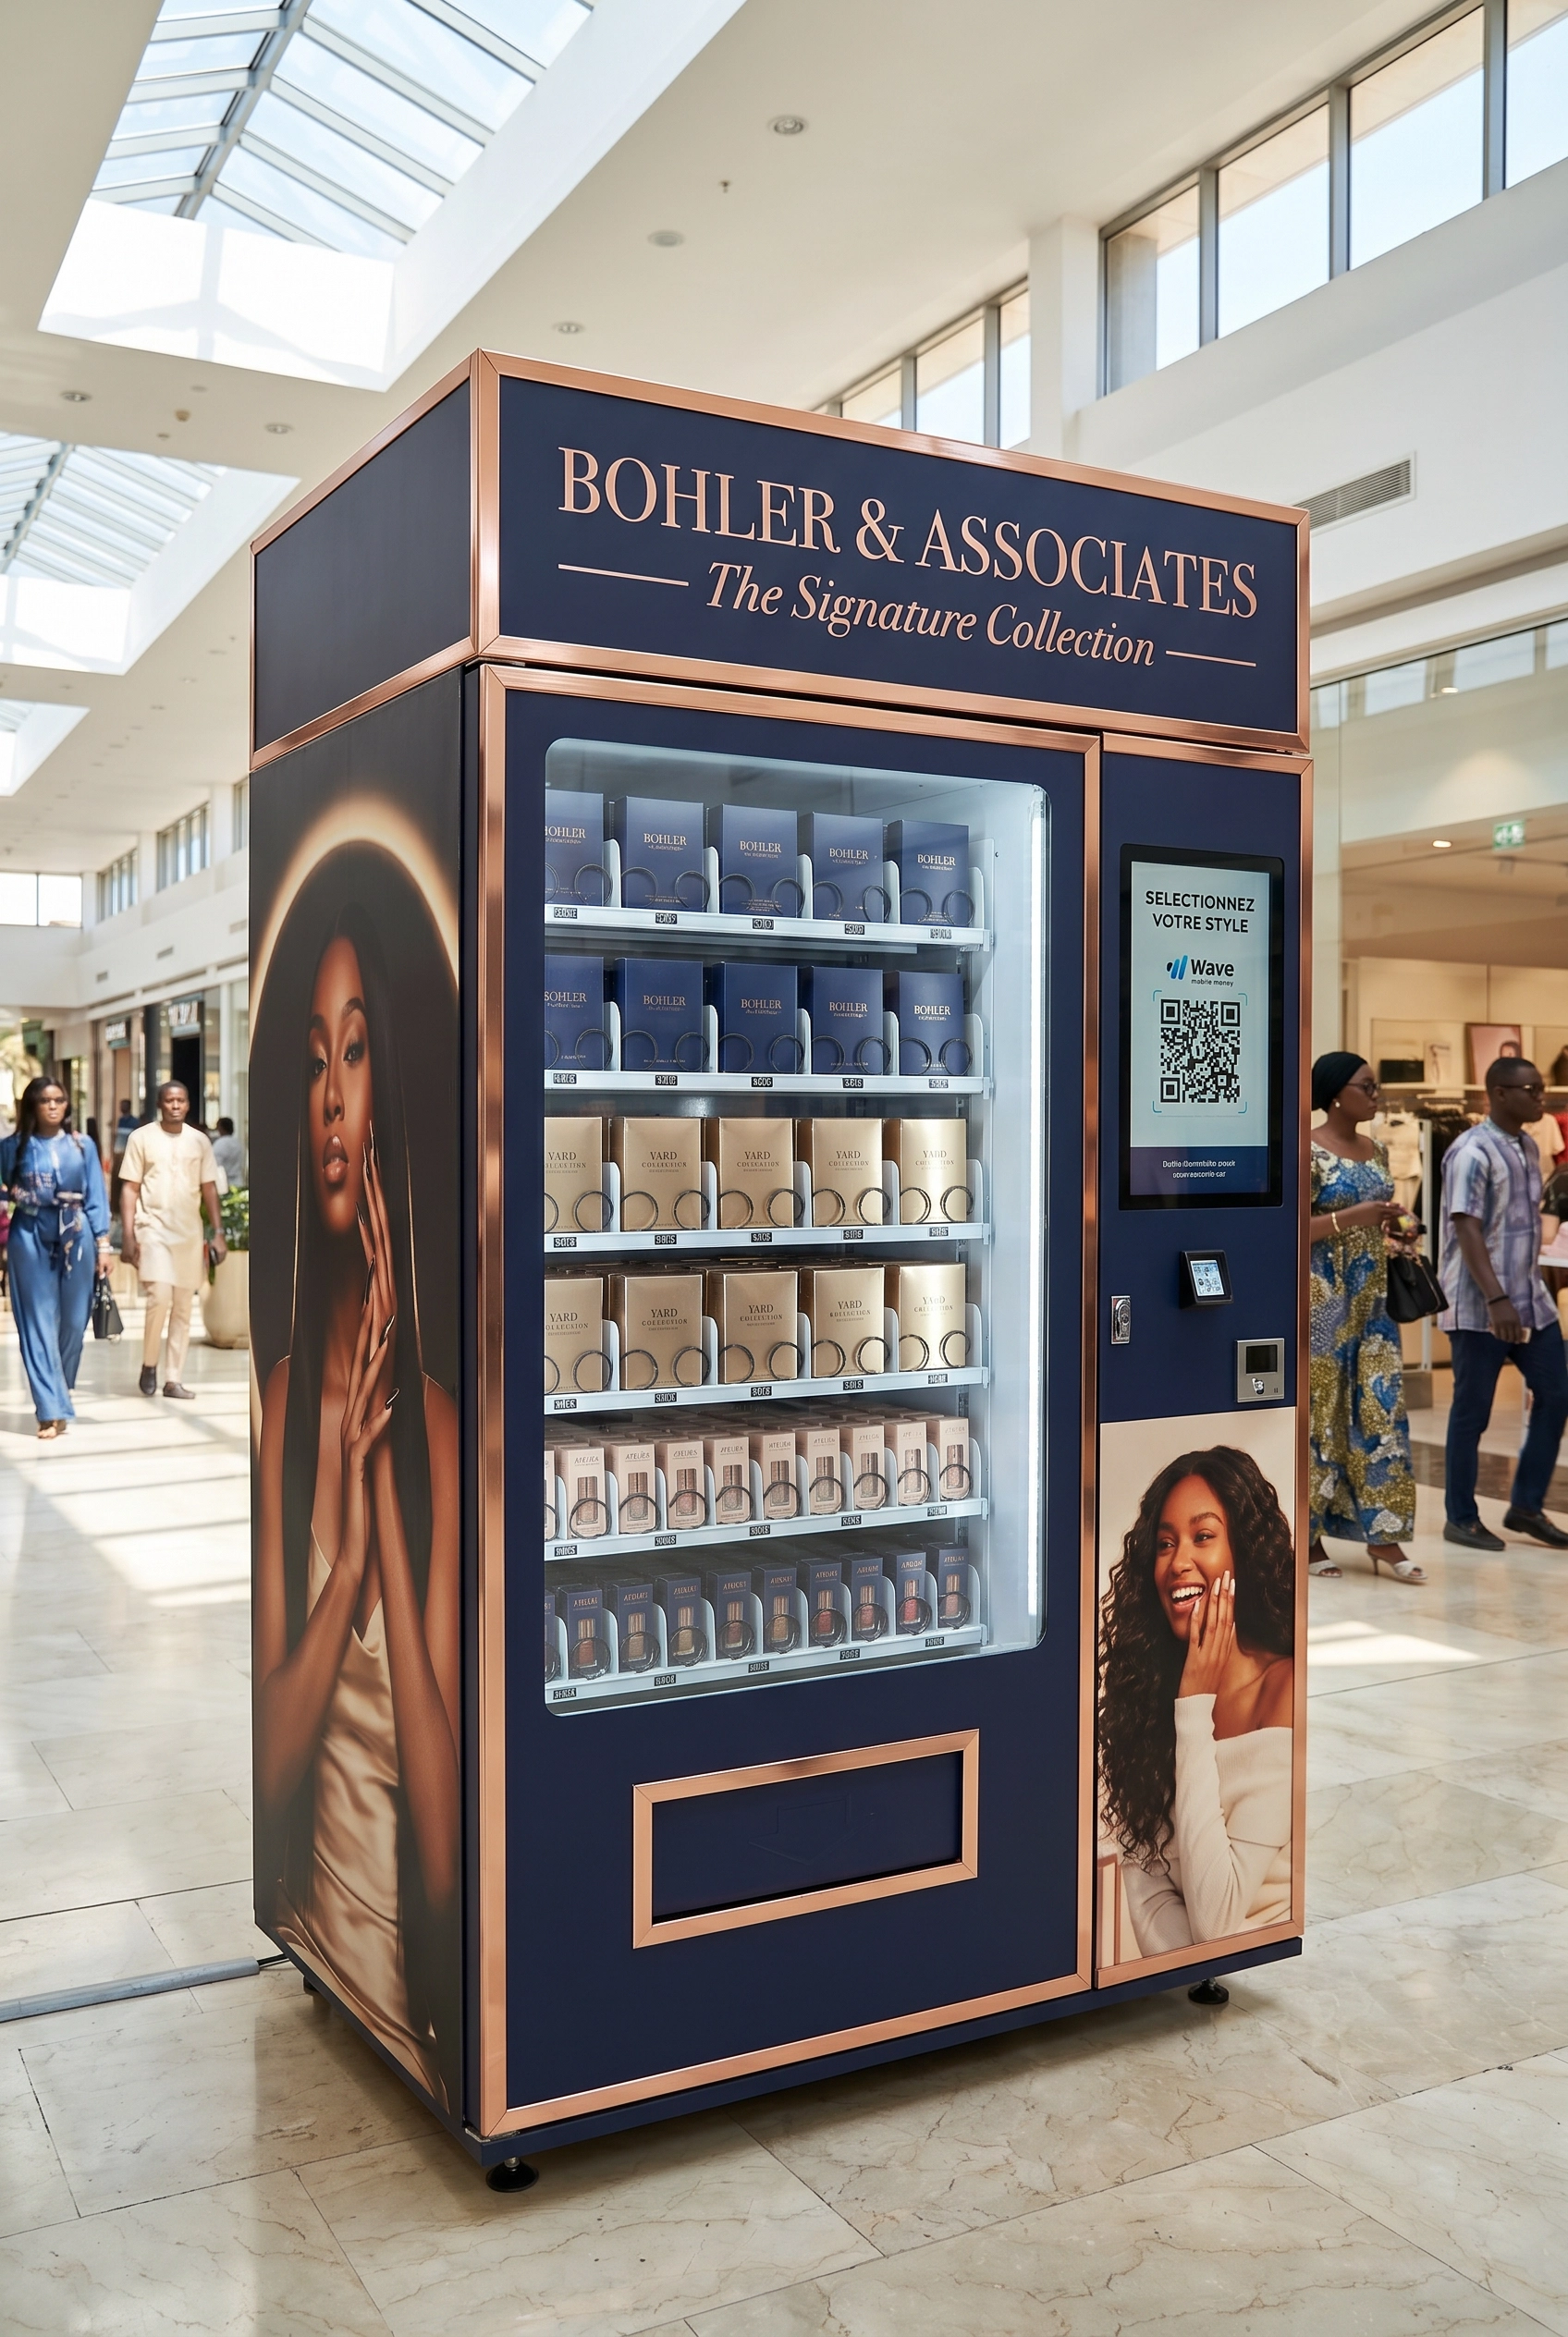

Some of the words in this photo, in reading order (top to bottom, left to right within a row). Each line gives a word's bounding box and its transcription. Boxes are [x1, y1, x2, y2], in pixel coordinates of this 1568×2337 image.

[558, 447, 841, 554] BOHLER
[856, 498, 905, 563] &
[915, 509, 1257, 618] ASSOCIATES
[706, 562, 783, 615] The
[790, 575, 977, 640] Signature
[987, 604, 1155, 666] Collection
[643, 833, 687, 846] BOHLER
[740, 840, 781, 853] BOHLER
[829, 848, 868, 860] BOHLER
[917, 854, 956, 866] BOHLER
[1145, 890, 1255, 912] SELECTIONNEZ
[1152, 913, 1201, 930] VOTRE
[1205, 917, 1248, 933] STYLE
[1191, 959, 1234, 977] Wave
[643, 995, 686, 1007] BOHLER
[741, 998, 782, 1009] BOHLER
[914, 1005, 950, 1016] BOHLER
[744, 1151, 771, 1160] YARD
[836, 1150, 861, 1159] YARD
[651, 1308, 678, 1318] YARD
[748, 1304, 774, 1314] YARD
[549, 1313, 578, 1322] YARD
